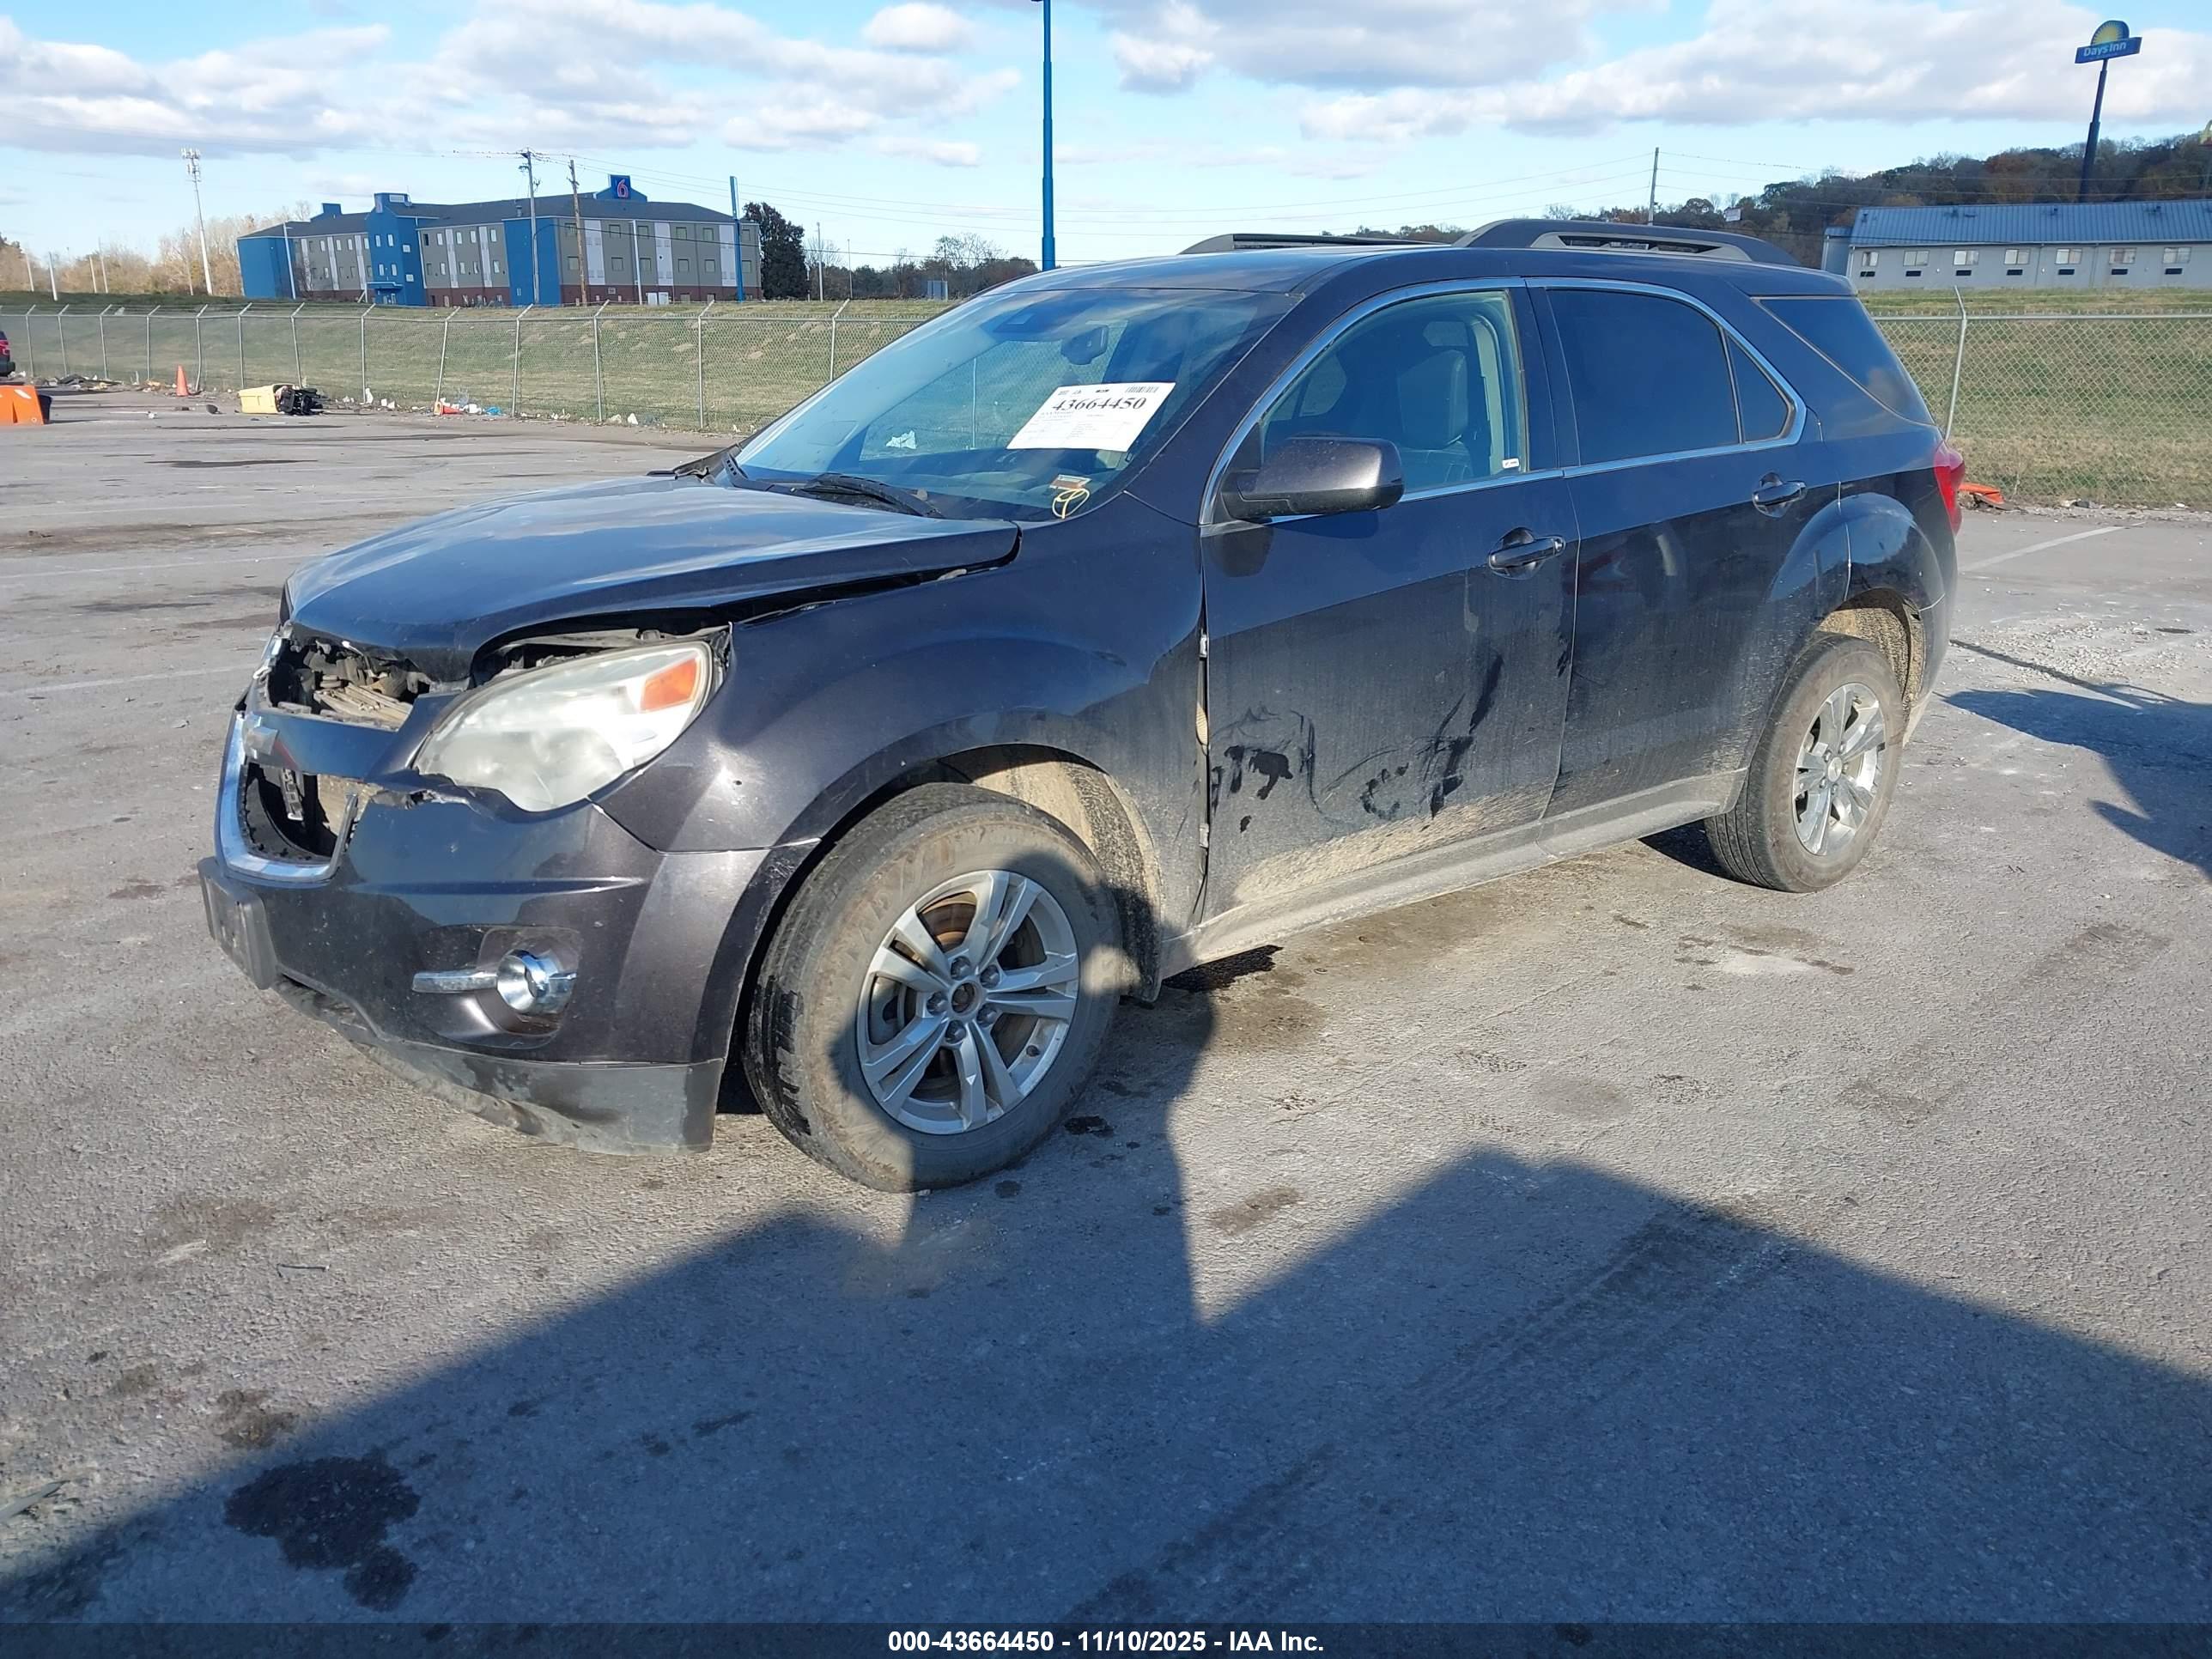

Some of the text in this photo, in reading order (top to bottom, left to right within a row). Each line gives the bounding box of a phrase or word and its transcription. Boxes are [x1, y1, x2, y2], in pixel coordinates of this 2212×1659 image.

[2083, 45, 2109, 57] Days
[2109, 42, 2127, 52] Inn
[617, 179, 629, 198] 6
[1053, 397, 1147, 411] 43664450
